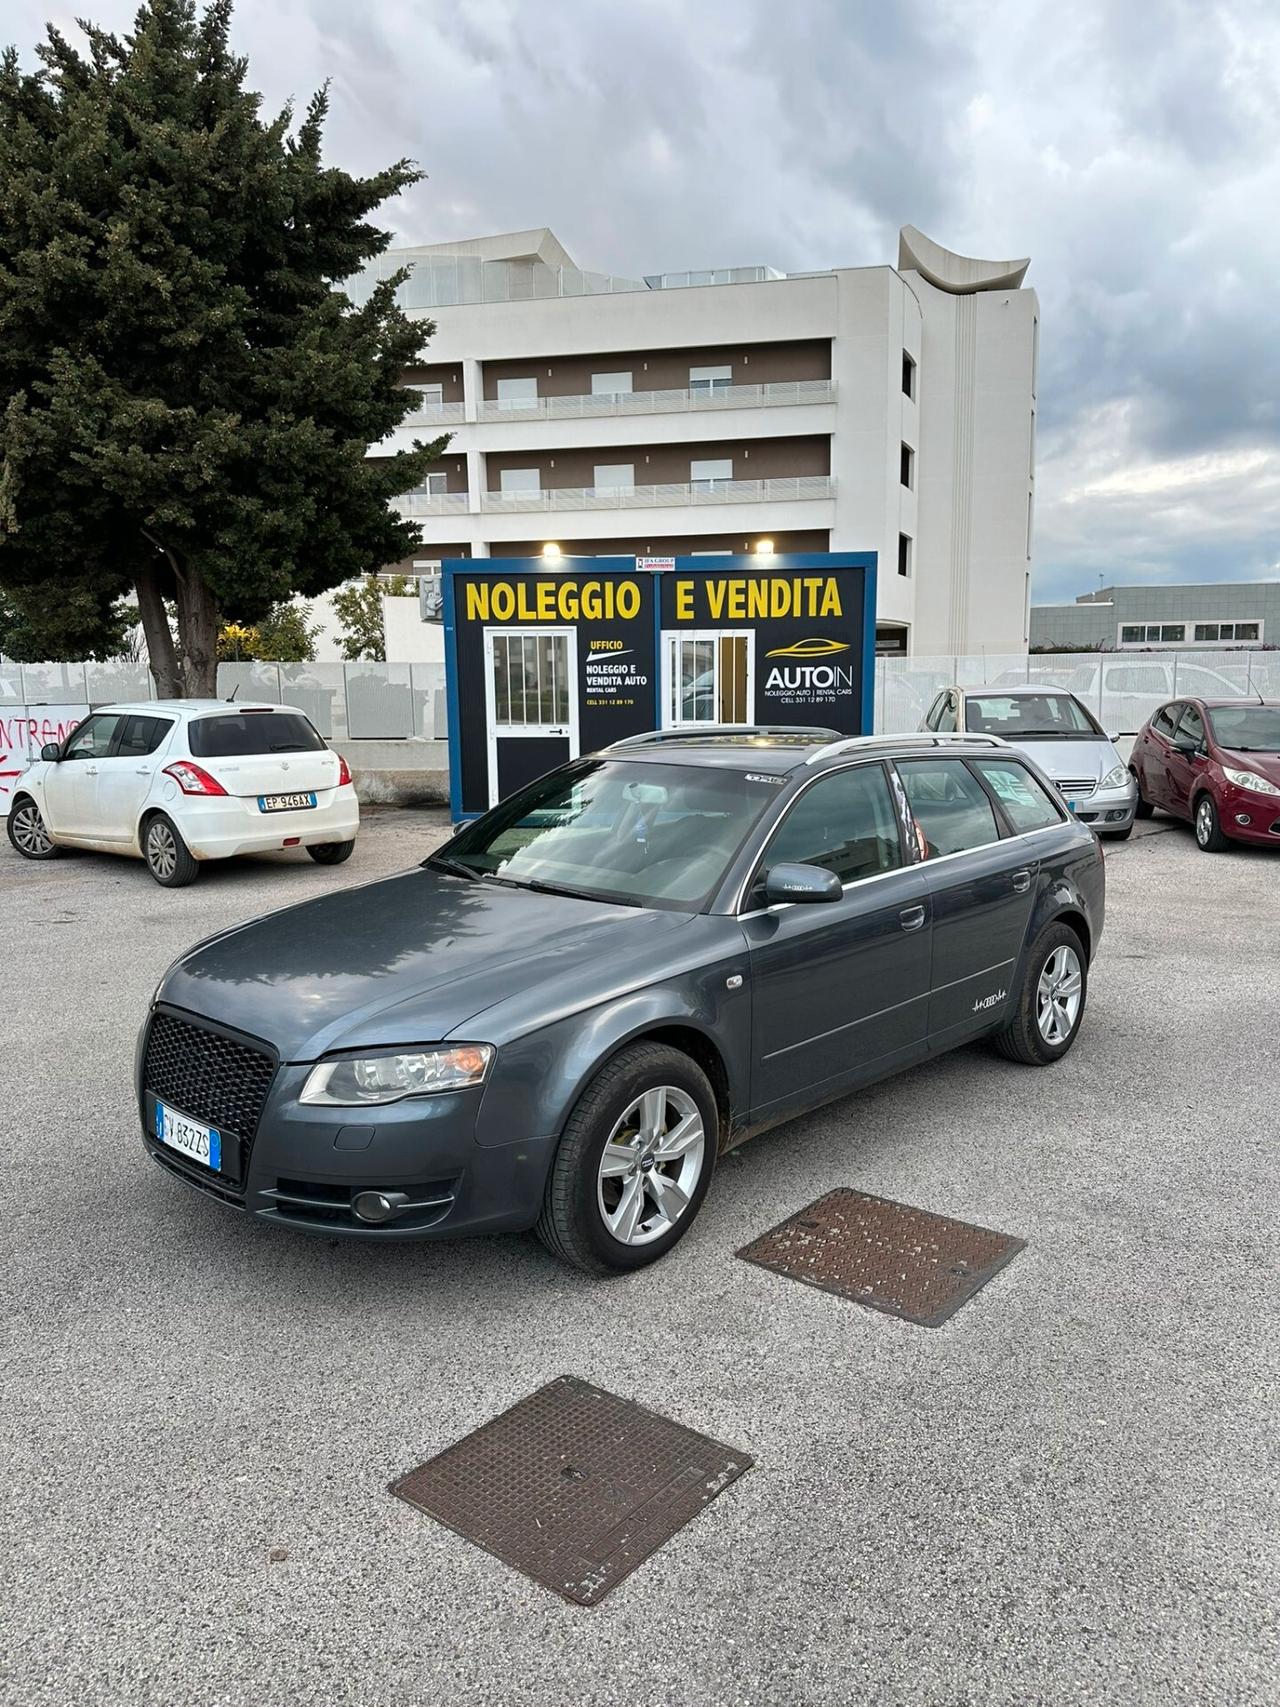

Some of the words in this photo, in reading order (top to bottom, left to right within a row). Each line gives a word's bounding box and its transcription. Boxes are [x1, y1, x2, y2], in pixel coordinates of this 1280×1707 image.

[466, 581, 641, 621] NOLEGGIO
[676, 581, 695, 620] E
[705, 577, 843, 619] VENDITA
[590, 640, 623, 650] UFFICIO
[586, 665, 628, 674] NOLEGGIO
[630, 665, 636, 674] E
[765, 665, 852, 689] AUTOIN
[586, 676, 622, 686] VENDITA
[624, 676, 647, 685] AUTO
[266, 797, 278, 809] EP
[280, 794, 310, 807] 946AX
[177, 1122, 209, 1157] 832ZS
